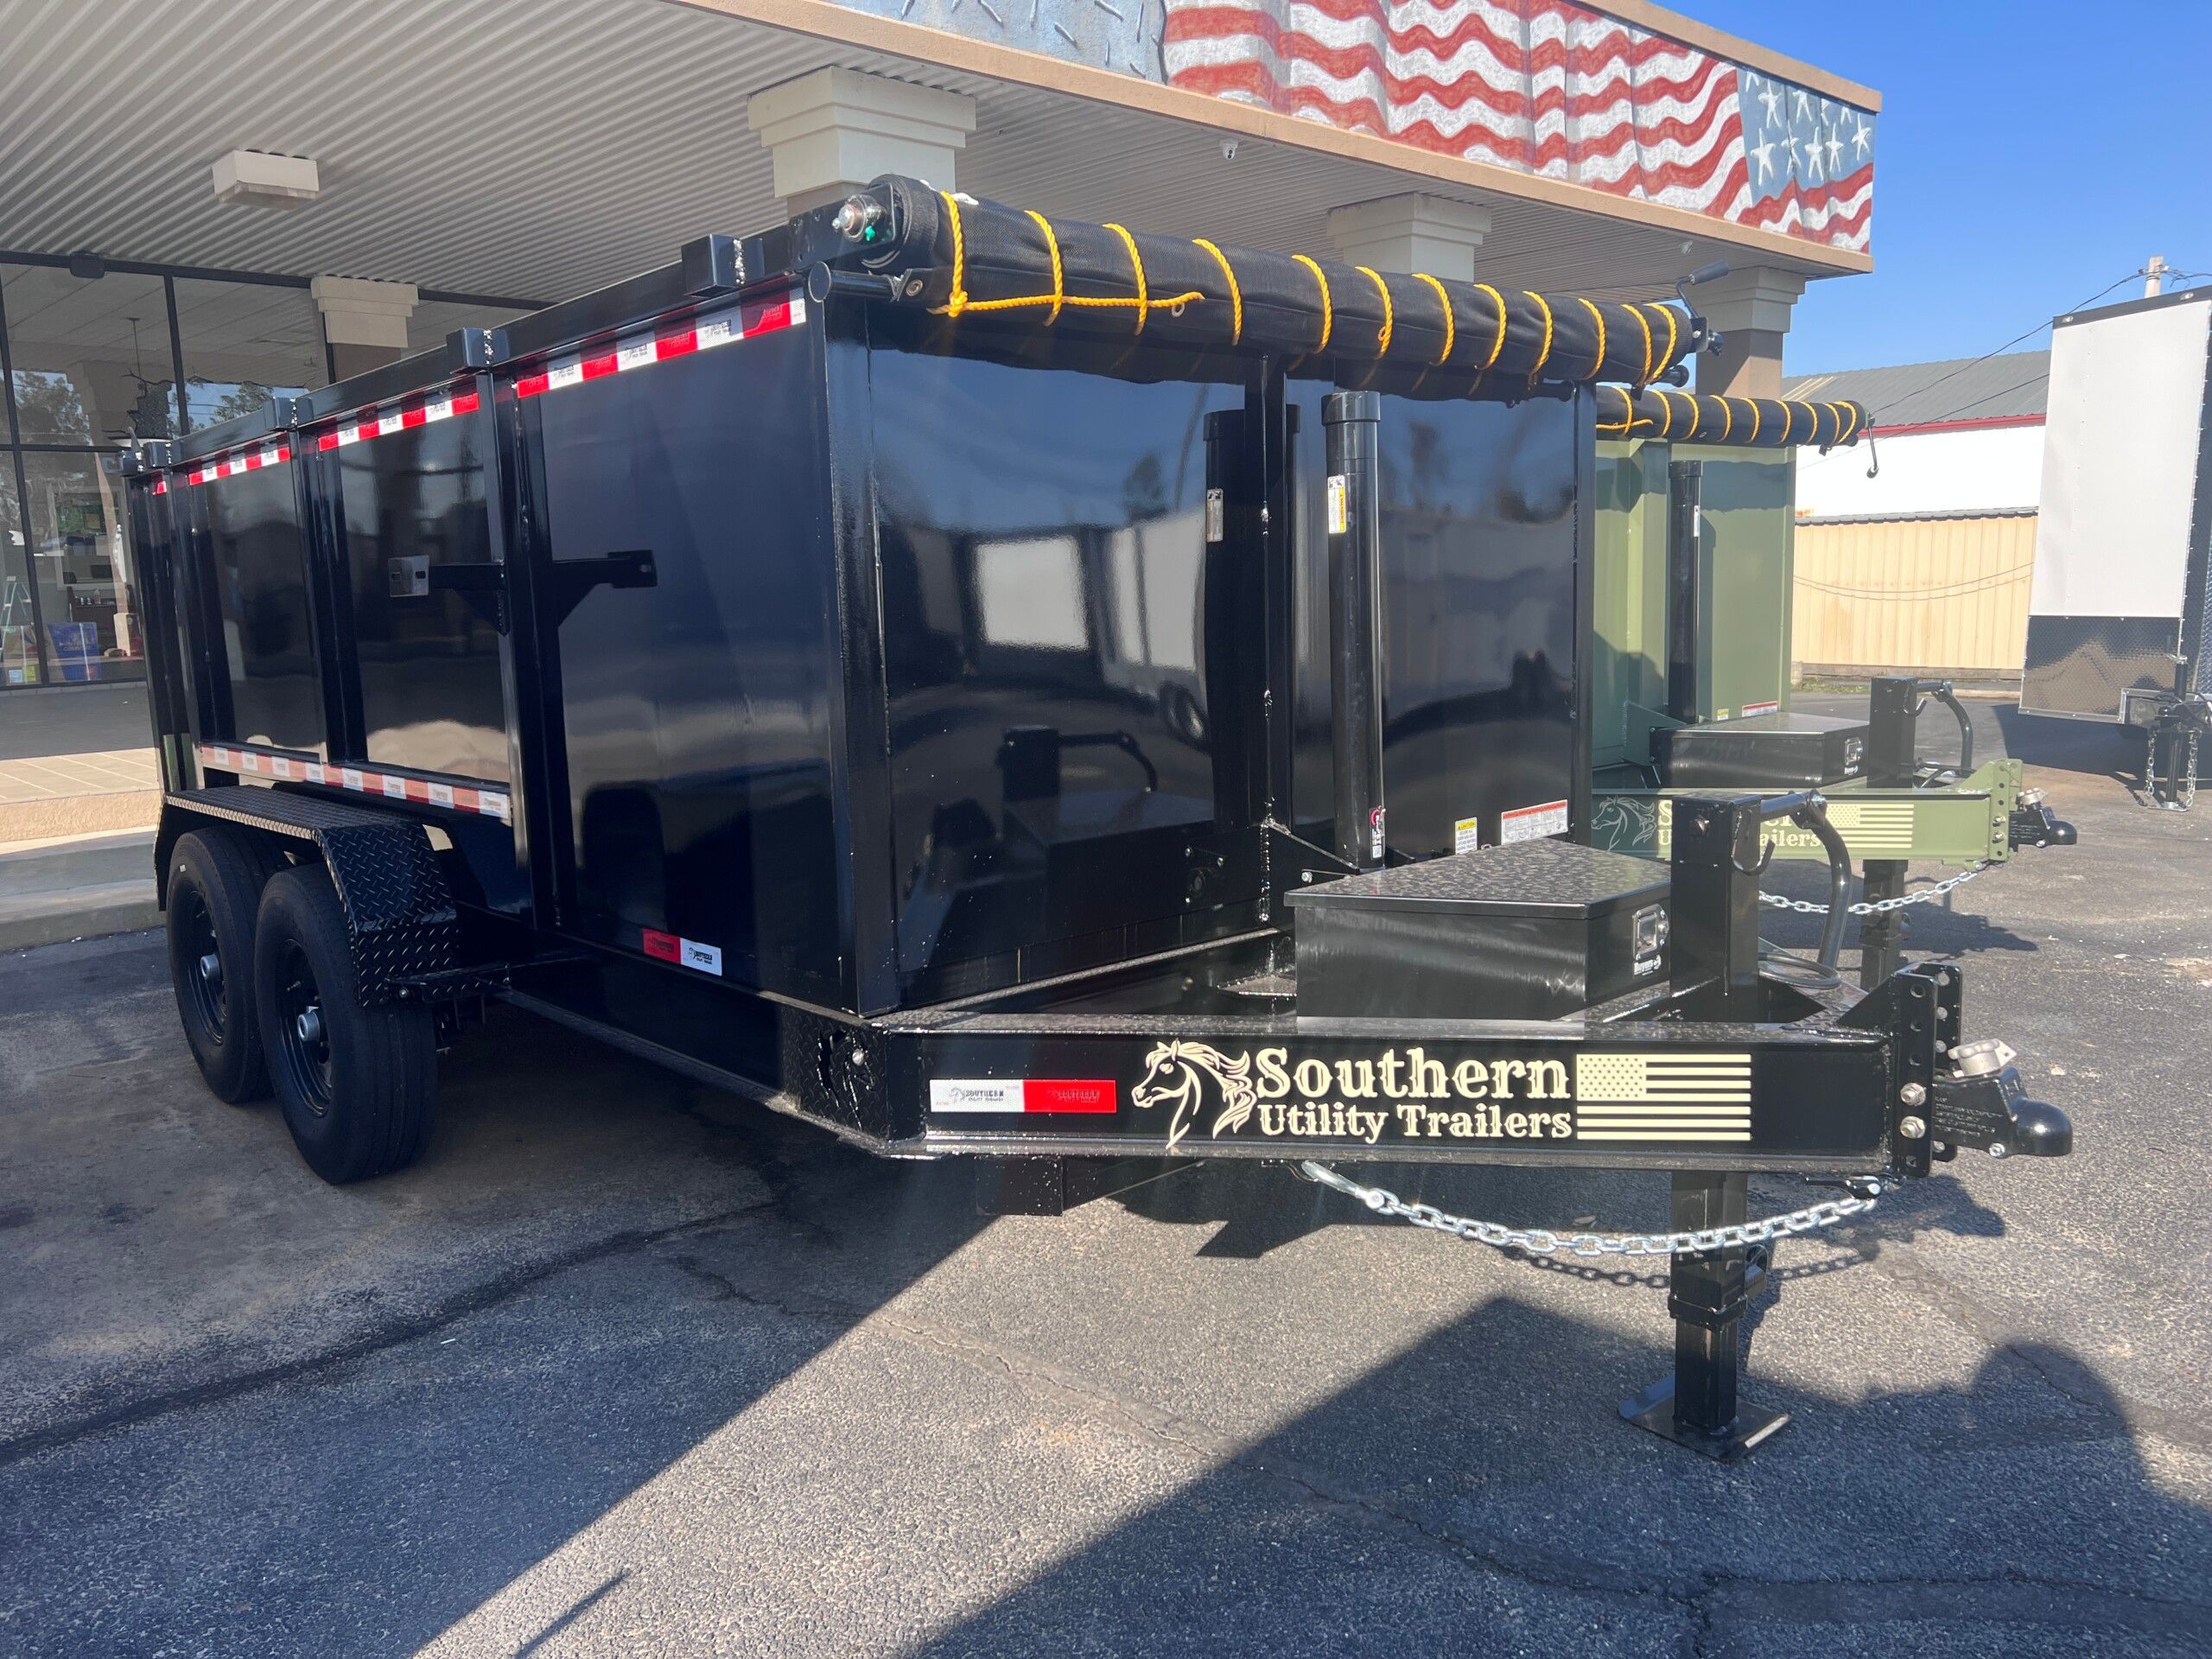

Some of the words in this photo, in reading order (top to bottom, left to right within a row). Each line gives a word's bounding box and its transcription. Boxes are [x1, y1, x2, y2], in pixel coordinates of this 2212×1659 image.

[1760, 829, 1821, 847] ailers
[1255, 1046, 1572, 1100] Southern
[1257, 1101, 1389, 1145] Utility
[1396, 1103, 1573, 1139] Trailers
